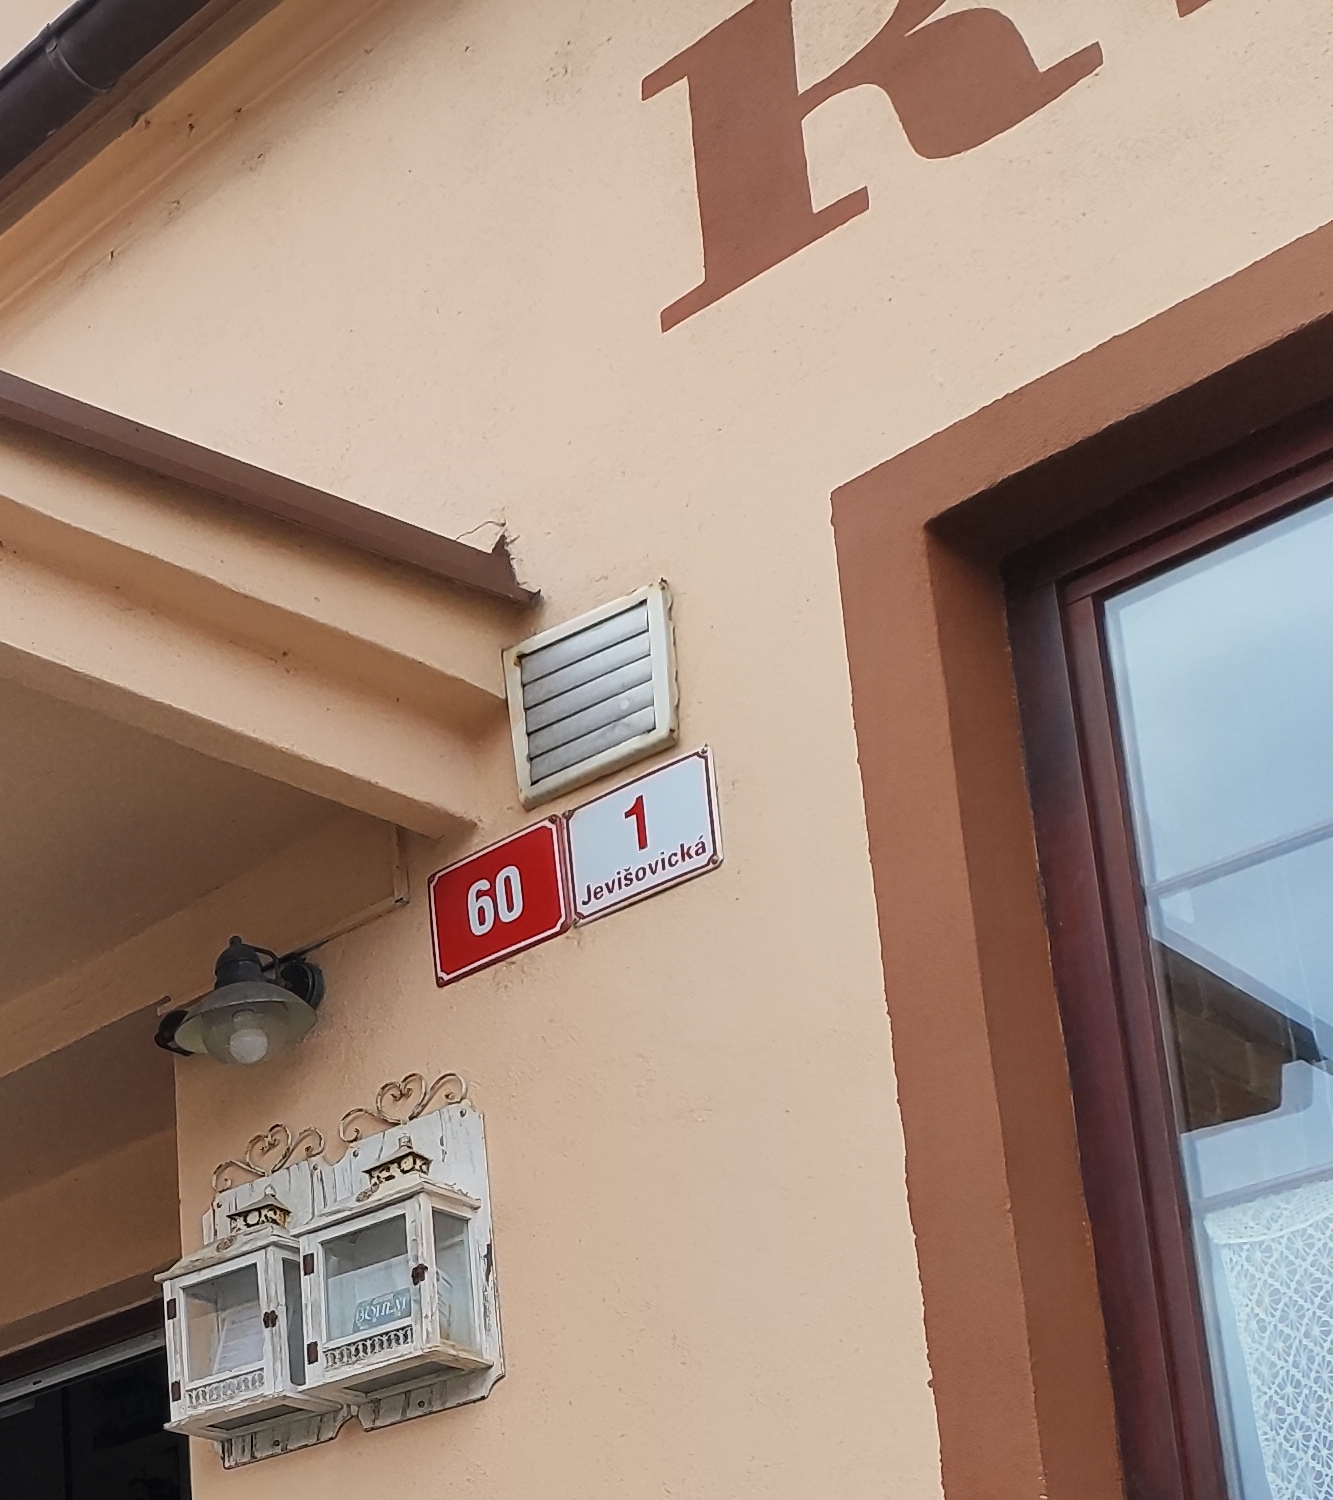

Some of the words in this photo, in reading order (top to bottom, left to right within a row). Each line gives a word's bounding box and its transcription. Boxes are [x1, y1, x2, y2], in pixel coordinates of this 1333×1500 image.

[624, 794, 648, 851] 1
[467, 865, 523, 936] 60
[581, 835, 707, 907] Jevišovická
